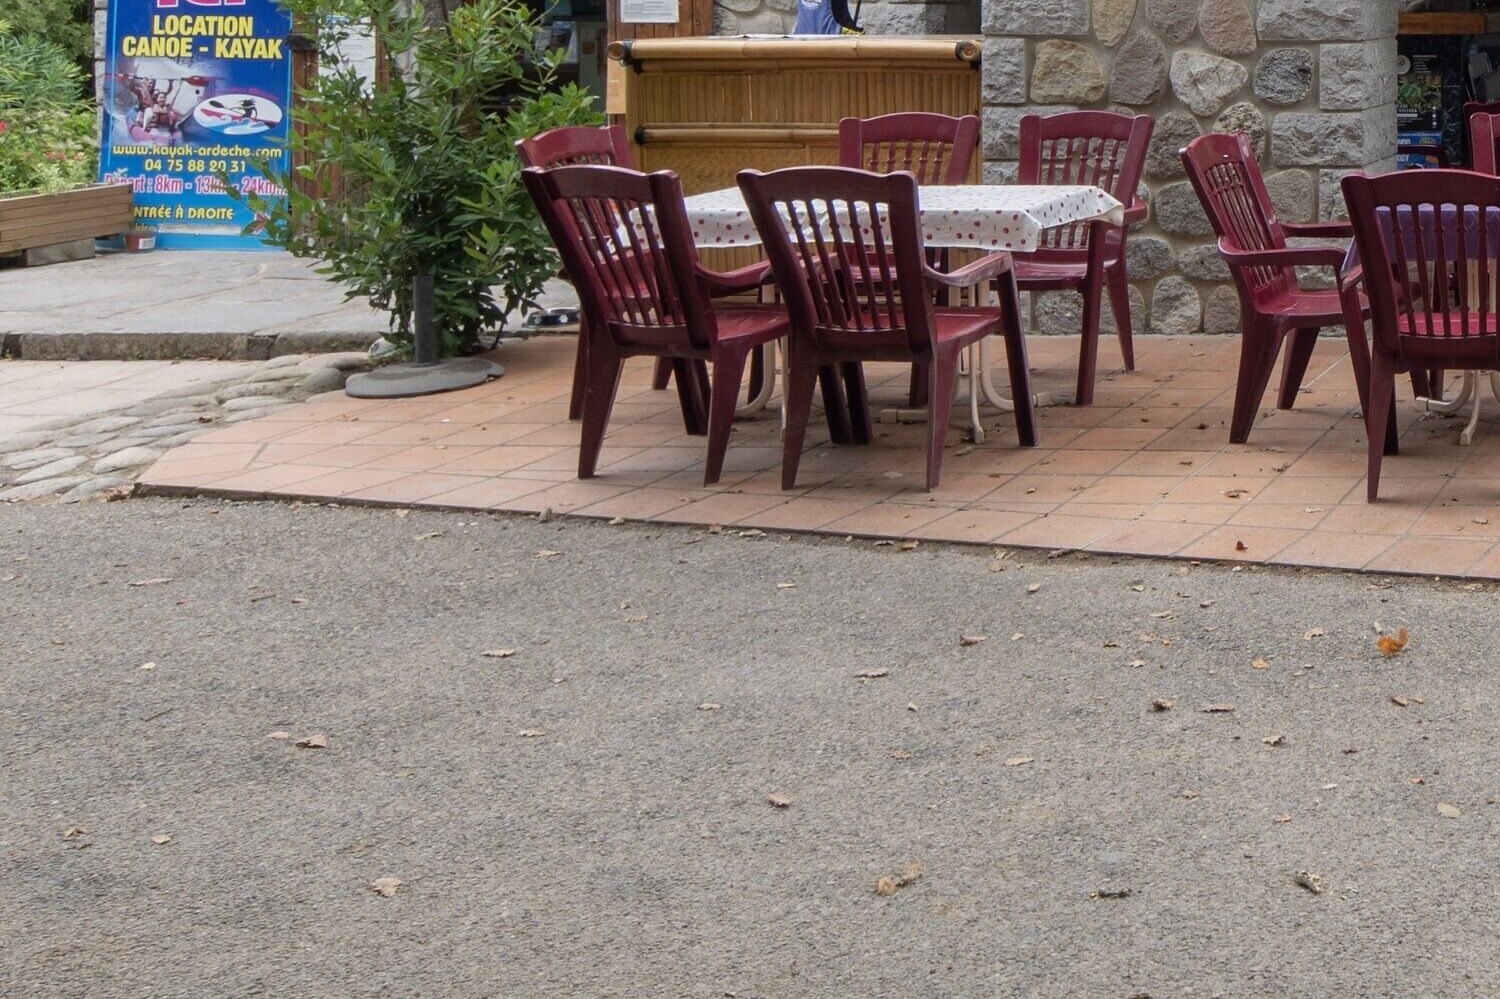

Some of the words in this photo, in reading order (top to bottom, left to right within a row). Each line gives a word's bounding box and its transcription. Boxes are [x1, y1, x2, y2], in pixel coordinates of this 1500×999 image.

[153, 15, 253, 37] LOCATION
[122, 36, 192, 57] CANOE
[215, 38, 283, 59] KAYAK
[112, 144, 282, 159] www.kayak-ardeche.com
[144, 159, 163, 172] 04
[167, 159, 183, 172] 75
[187, 160, 205, 173] 88
[209, 160, 227, 173] 20
[230, 160, 246, 173] 31
[154, 174, 184, 194] 8km
[133, 204, 172, 219] NTRÉE
[188, 207, 234, 220] DROITE
